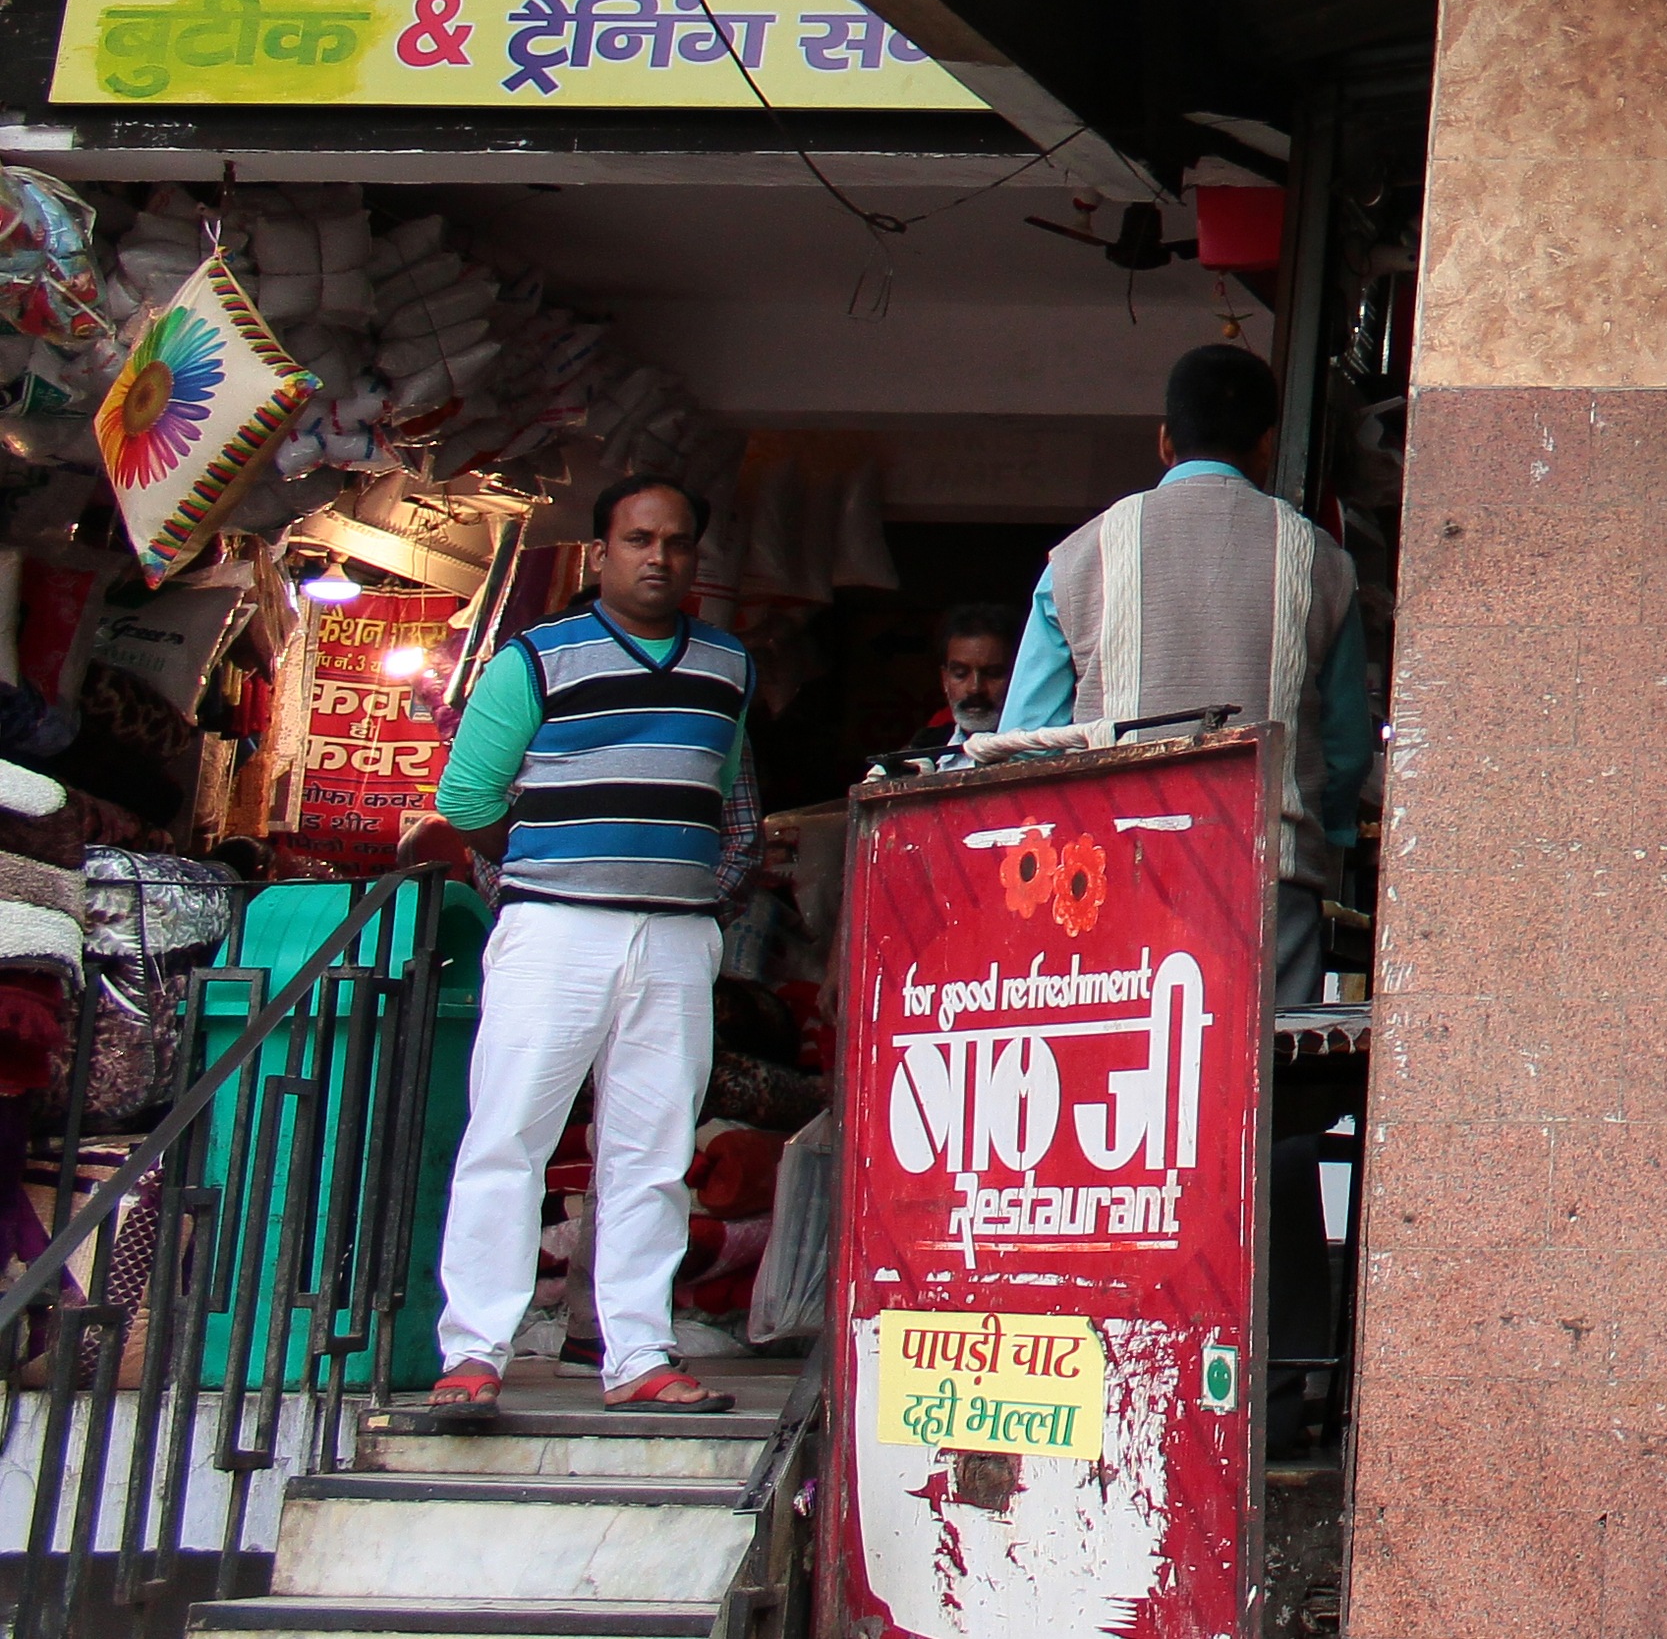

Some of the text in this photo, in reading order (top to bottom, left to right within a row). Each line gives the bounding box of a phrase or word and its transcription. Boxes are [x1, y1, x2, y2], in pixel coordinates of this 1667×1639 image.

[331, 811, 383, 834] शीट
[364, 792, 427, 808] कवर
[902, 947, 1151, 1030] for good refreshment
[949, 1170, 1182, 1268] Restaurant
[902, 1313, 1081, 1385] पापड़ी चाट
[902, 1380, 1081, 1449] दही भल्ला
